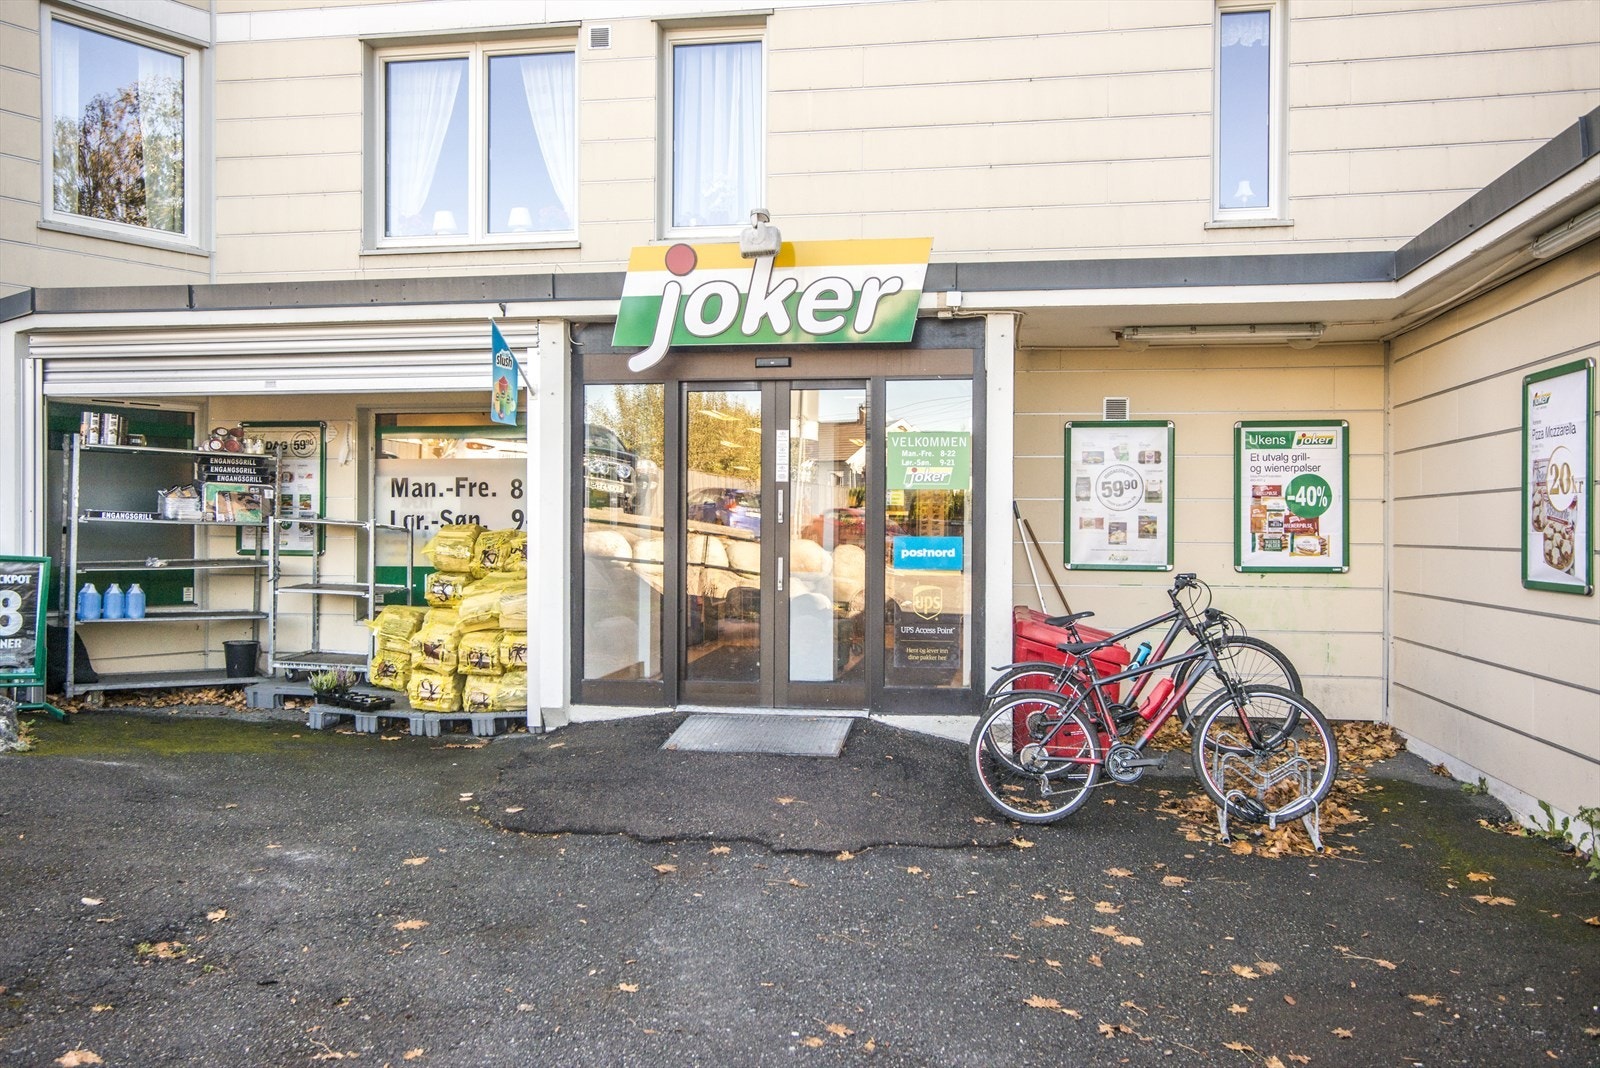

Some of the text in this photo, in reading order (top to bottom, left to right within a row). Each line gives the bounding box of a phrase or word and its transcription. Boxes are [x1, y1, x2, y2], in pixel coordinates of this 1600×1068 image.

[628, 243, 904, 373] joker
[496, 353, 513, 368] slush
[891, 437, 967, 447] VELKOMMEN
[1249, 433, 1332, 447] Ukens joker
[209, 457, 257, 466] ENGANGSGRILL
[1250, 453, 1310, 463] Et utvalg grill-
[210, 466, 257, 475] ENGANGSGRILL
[1249, 464, 1322, 474] og wienerpølser
[216, 475, 263, 483] ENGANGSGRILL
[904, 467, 948, 488] joker
[391, 476, 497, 498] Man.-Fre.
[1287, 485, 1328, 507] -40%
[101, 511, 153, 520] ENGANGSGRILL
[901, 548, 955, 558] postnord
[915, 596, 940, 614] ups
[900, 626, 914, 634] UPS
[915, 626, 936, 634] Access
